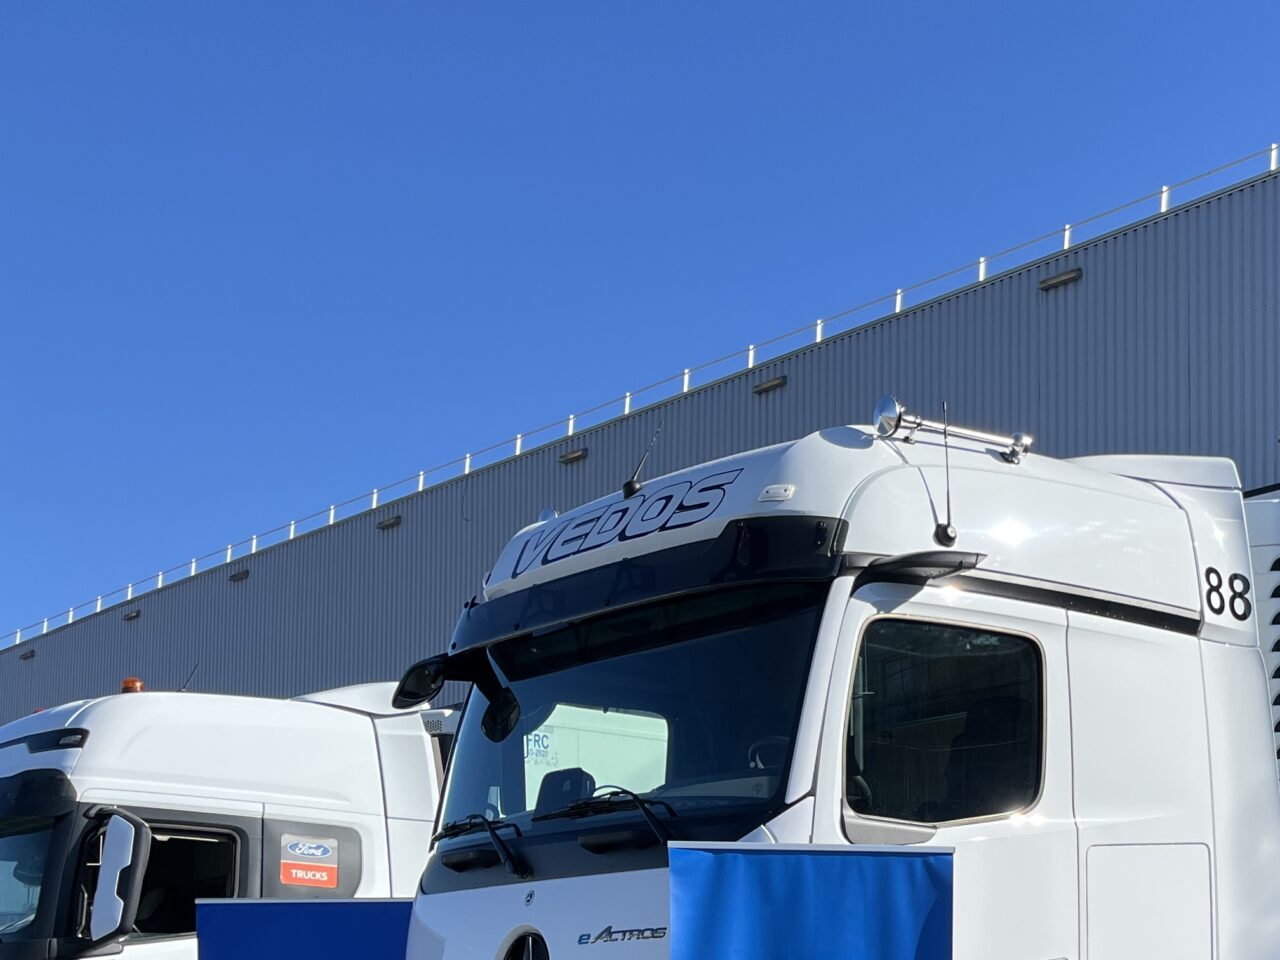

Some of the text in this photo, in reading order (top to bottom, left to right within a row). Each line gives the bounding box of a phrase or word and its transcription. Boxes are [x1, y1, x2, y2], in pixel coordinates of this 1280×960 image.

[511, 468, 744, 579] VEDOS
[1205, 567, 1252, 621] 88
[527, 733, 549, 750] FRC
[291, 869, 328, 881] TRUCKS
